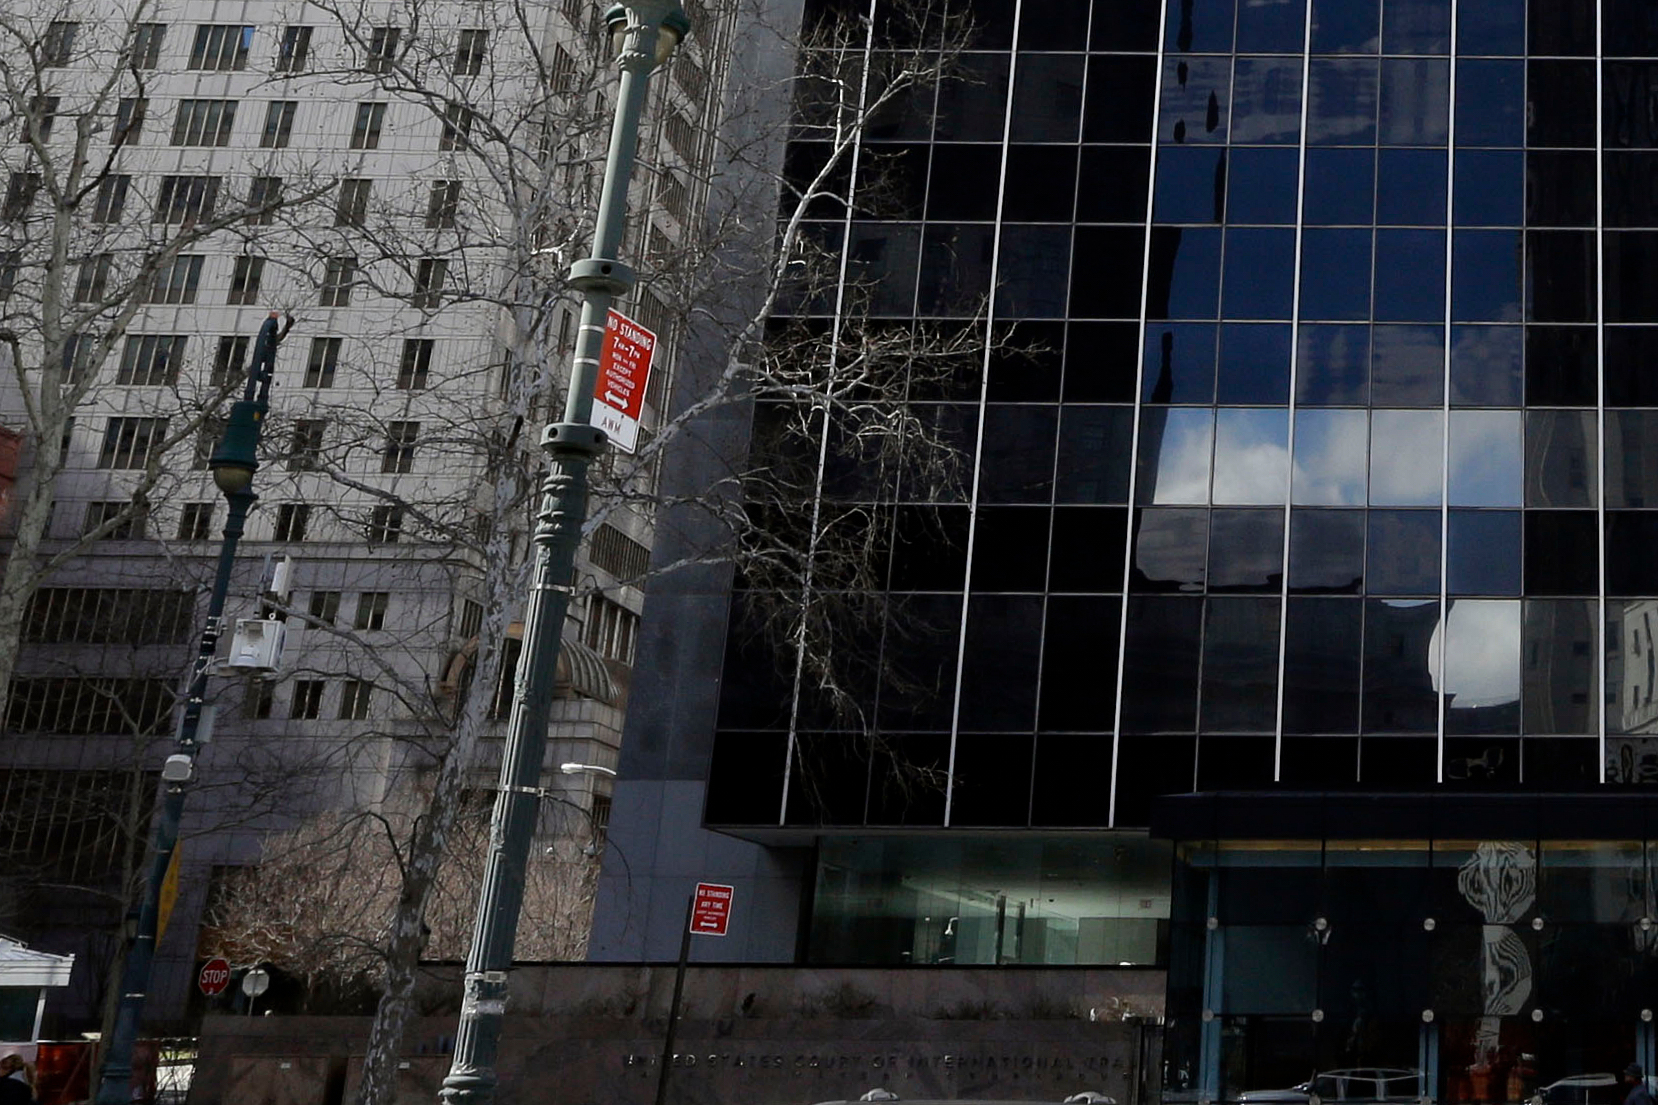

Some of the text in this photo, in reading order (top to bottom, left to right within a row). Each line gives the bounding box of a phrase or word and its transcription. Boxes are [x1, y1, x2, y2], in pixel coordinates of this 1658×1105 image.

[607, 315, 652, 351] NO STANDING
[612, 361, 632, 377] EXCEPT
[605, 368, 635, 390] AUTHORIZED
[607, 379, 630, 397] VEHICLES
[202, 969, 228, 984] STOP
